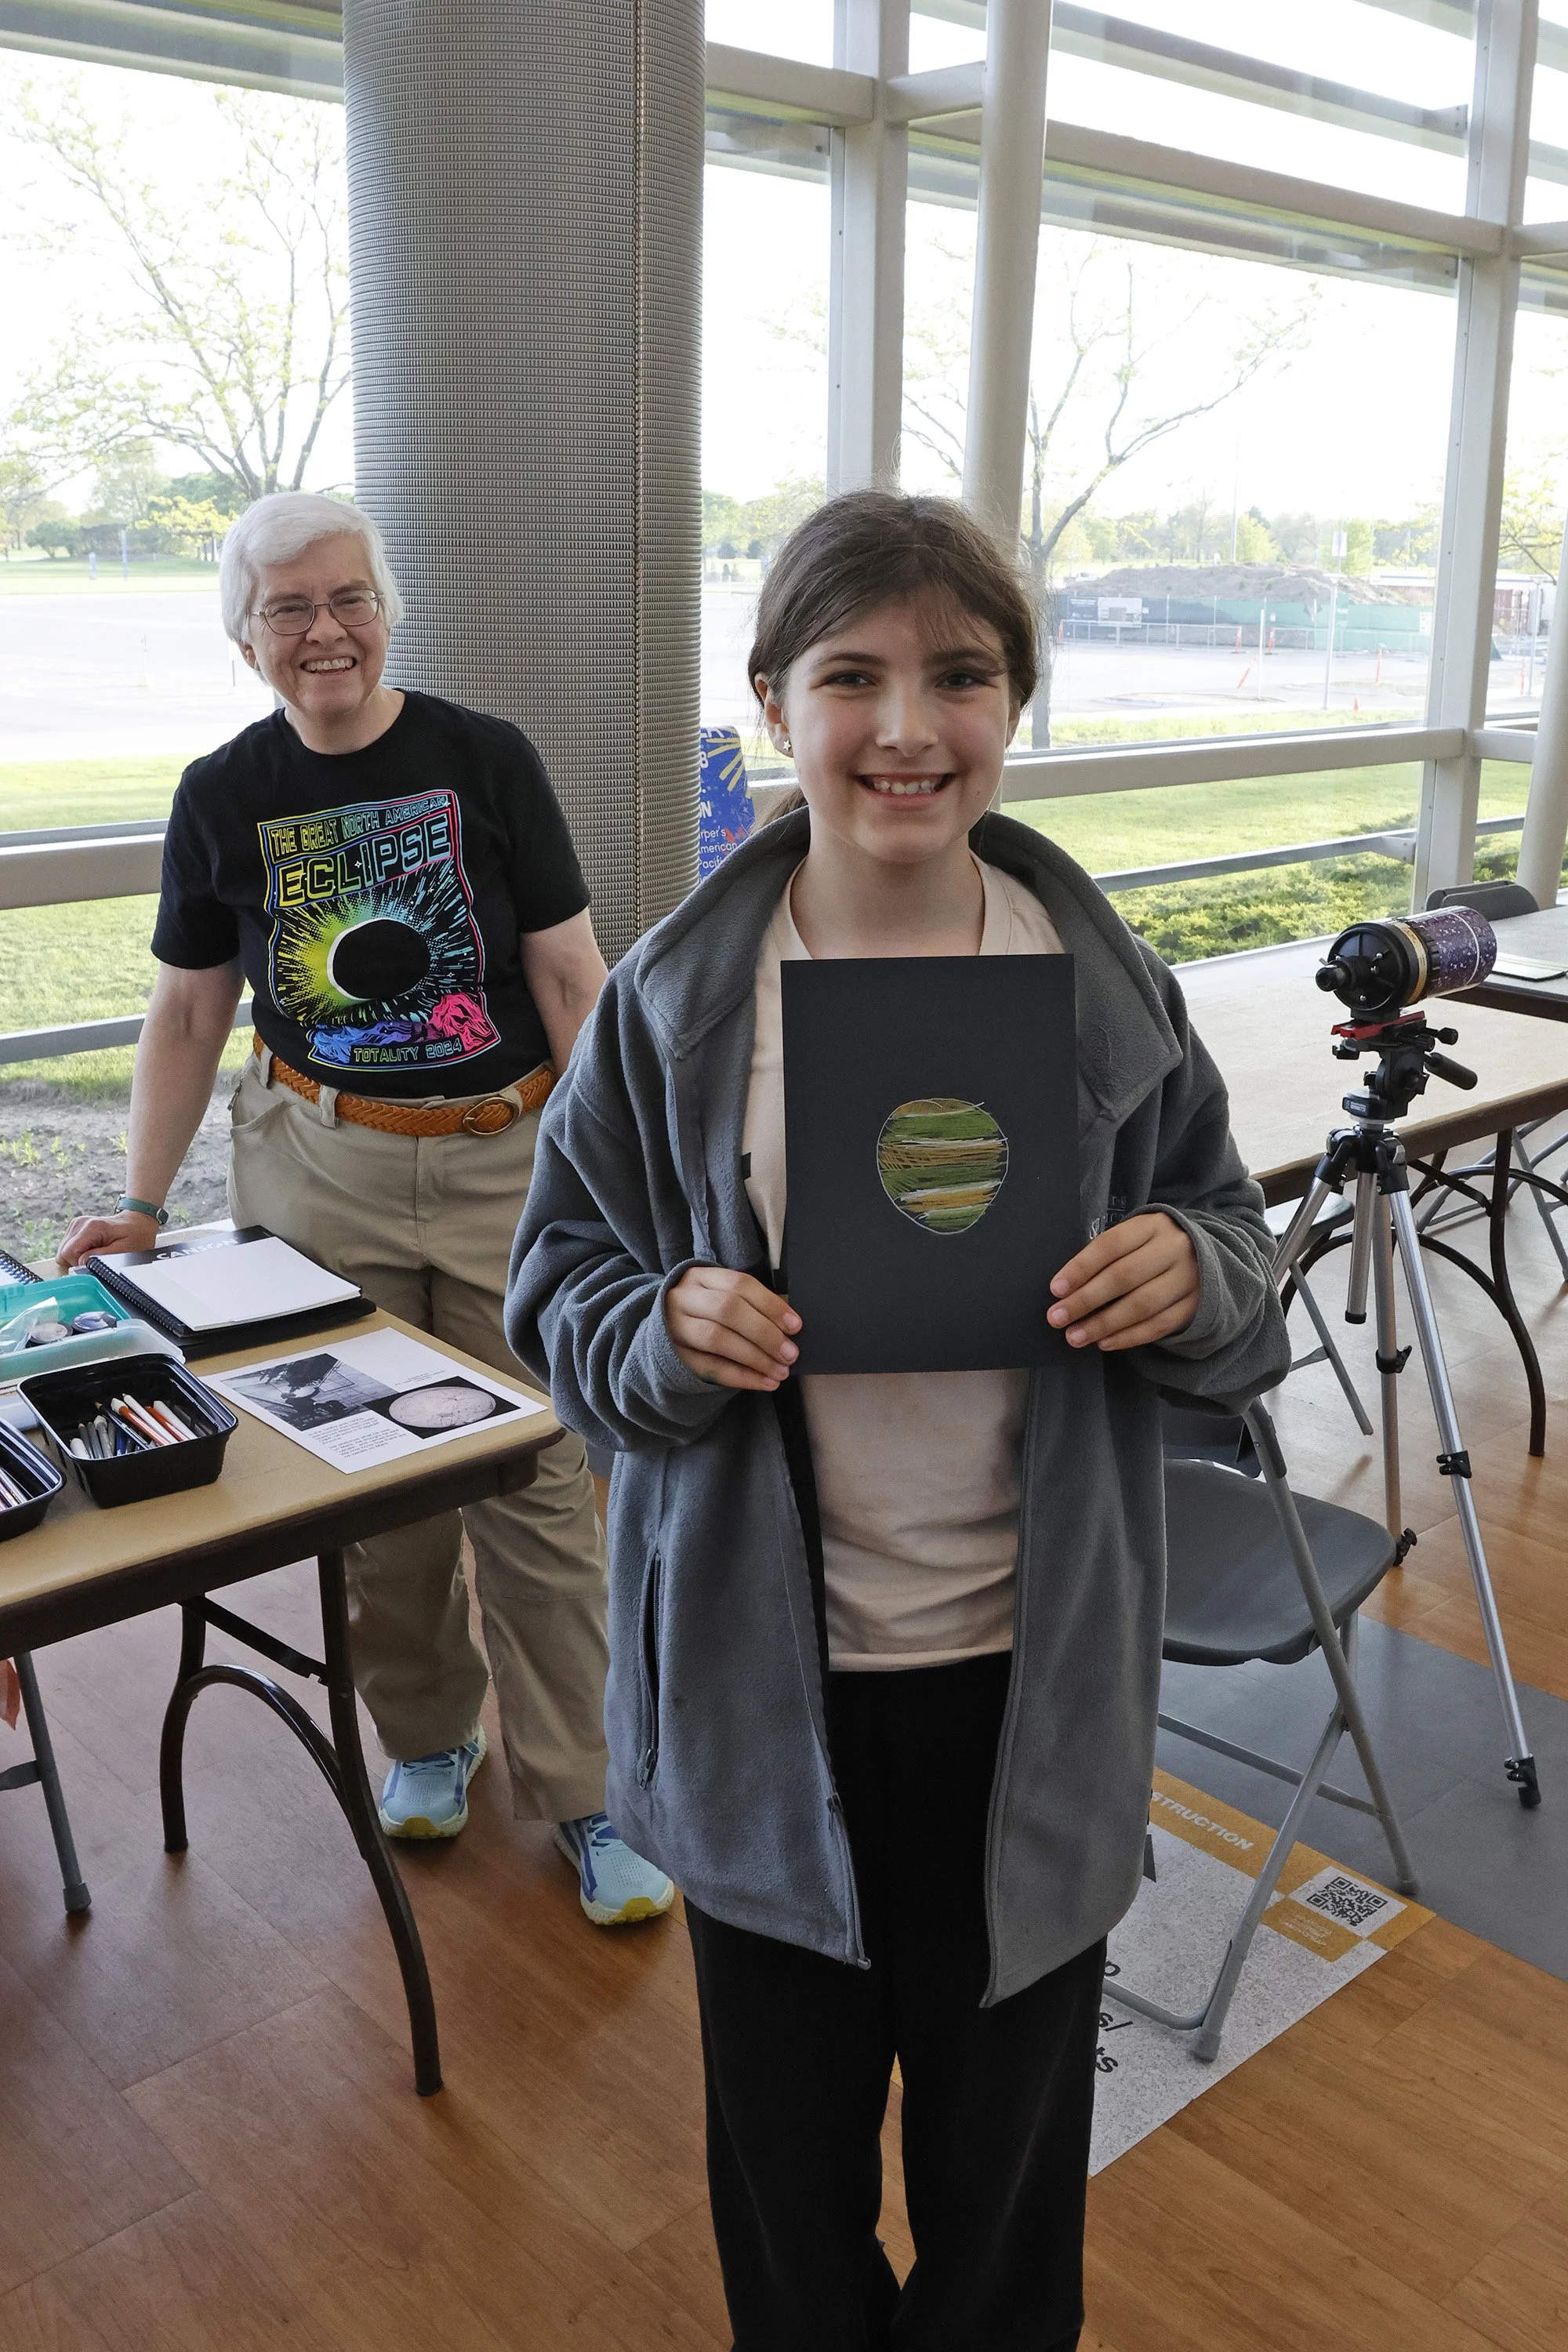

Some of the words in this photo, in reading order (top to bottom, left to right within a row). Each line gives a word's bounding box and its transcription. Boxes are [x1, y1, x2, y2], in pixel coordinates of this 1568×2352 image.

[270, 826, 297, 856] THE
[300, 819, 339, 851] GREAT
[341, 811, 380, 840] NORTH
[385, 797, 447, 824] AMERICAN
[700, 826, 726, 842] rper's
[279, 813, 451, 907] ECLIPSE
[699, 842, 738, 854] merican
[354, 1046, 419, 1062] TOTALITY
[426, 1037, 462, 1058] 2024
